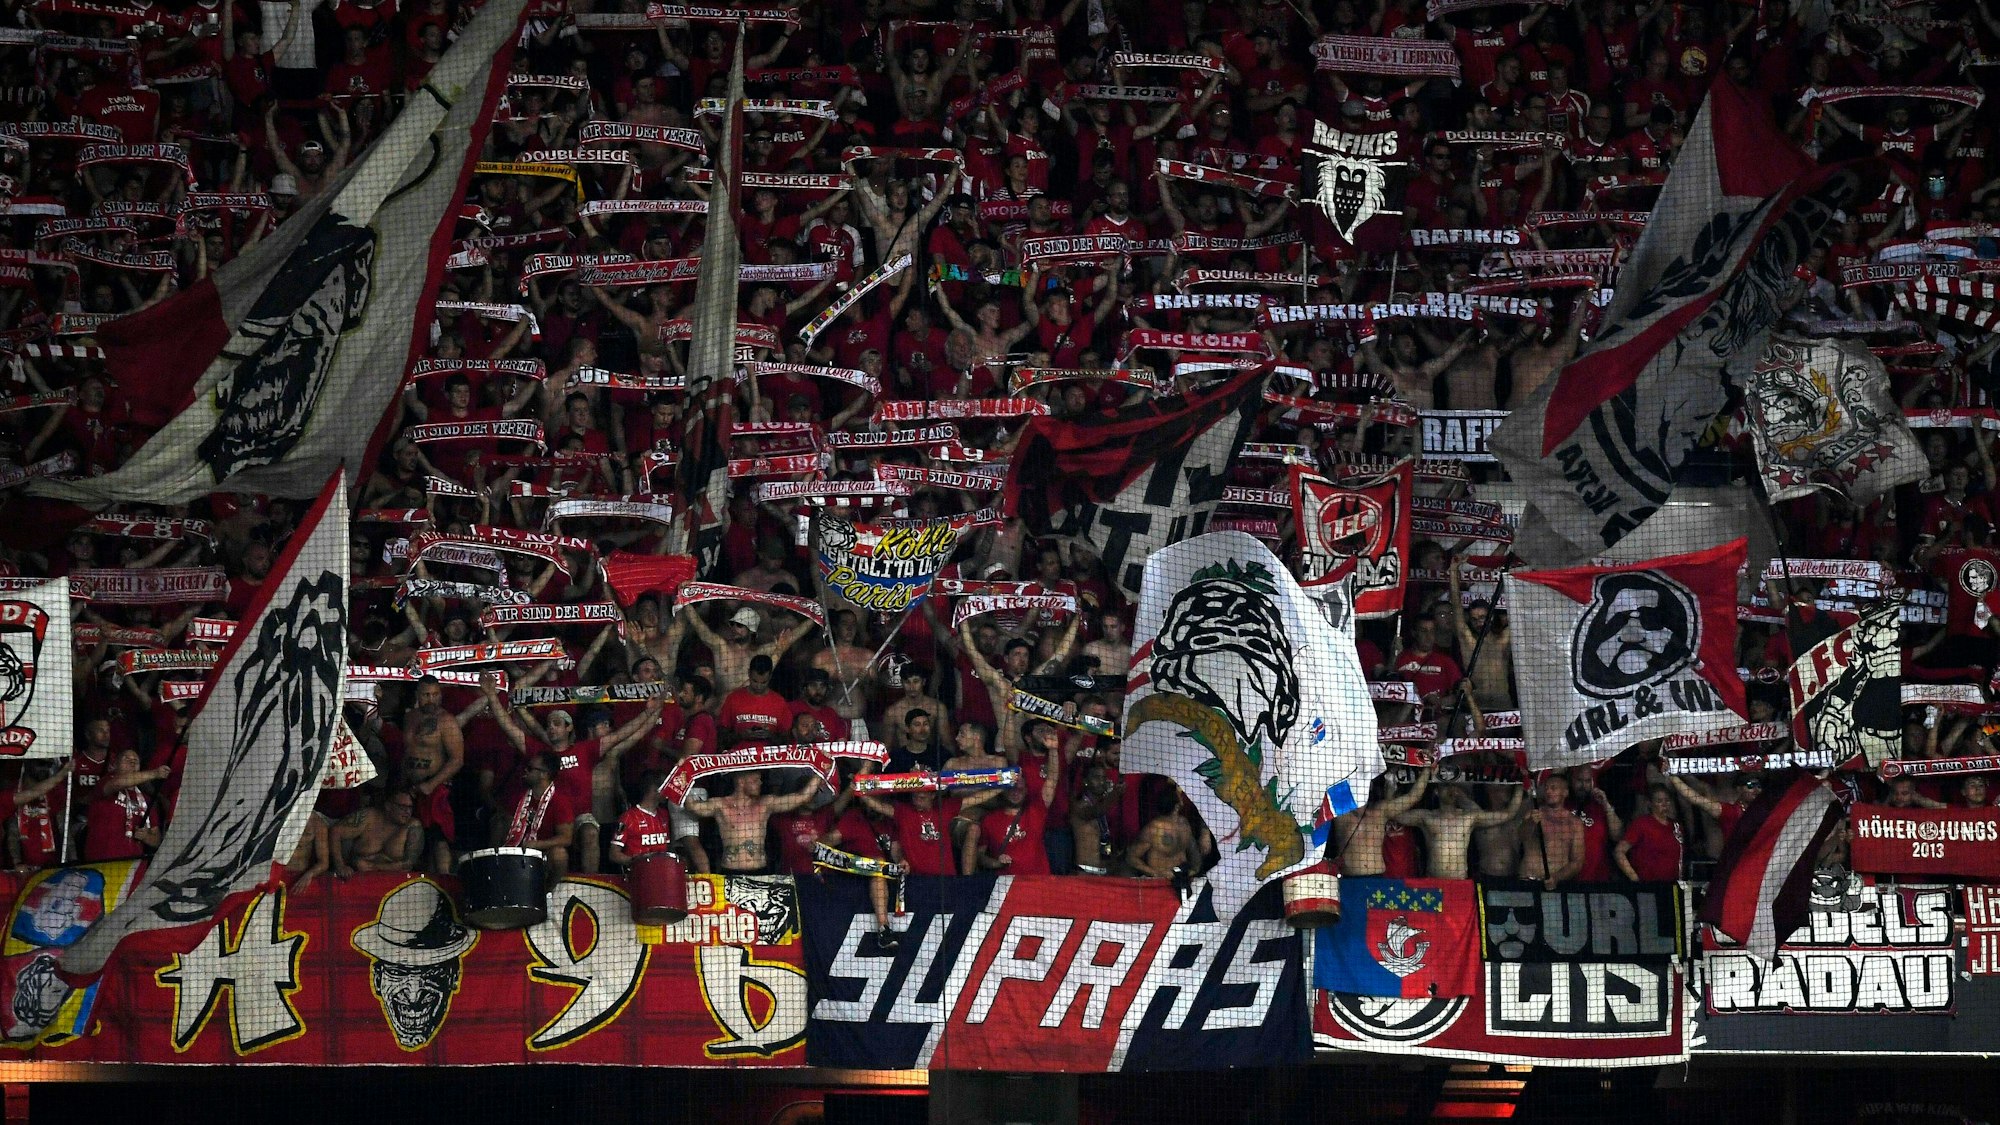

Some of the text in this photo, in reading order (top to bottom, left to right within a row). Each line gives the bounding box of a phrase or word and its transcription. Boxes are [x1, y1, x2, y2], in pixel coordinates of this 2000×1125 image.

[1332, 46, 1375, 61] VEEDEL
[1098, 87, 1118, 95] FC
[20, 122, 49, 133] SIND
[52, 122, 76, 134] DER
[582, 124, 601, 139] WIR
[604, 124, 632, 136] SIND
[635, 126, 659, 138] DER
[774, 131, 806, 142] REWE
[1312, 118, 1398, 155] RAFIKIS
[99, 144, 128, 157] SIND
[131, 144, 154, 156] DER
[1882, 141, 1914, 153] REWE
[103, 202, 131, 213] SIND
[678, 201, 707, 212] Köln
[54, 219, 82, 231] SIND
[1411, 229, 1520, 246] RAFIKIS
[1024, 238, 1093, 256] WIR SIND DER
[525, 256, 542, 274] WIR
[545, 256, 573, 268] SIND
[1843, 268, 1863, 284] WIR
[1867, 266, 1896, 280] SIND
[1898, 264, 1921, 277] DER
[1154, 293, 1262, 309] RAFIKIS
[1427, 291, 1538, 318] RAFIKIS
[1268, 304, 1366, 323] RAFIKIS
[1372, 303, 1473, 320] RAFIKIS
[1160, 333, 1183, 346] FC
[1191, 332, 1247, 348] KÖLN
[432, 359, 461, 371] SIND
[467, 359, 489, 369] DER
[492, 360, 538, 374] VEREIN
[431, 423, 537, 439] SIND DER VEREIN
[855, 431, 887, 445] SIND
[891, 430, 916, 443] DIE
[920, 424, 954, 441] FANS
[897, 468, 992, 490] WIR SIND DIE
[768, 481, 876, 497] Fussballclub Köln
[154, 523, 172, 538] 8
[873, 522, 958, 561] Kölle
[1841, 563, 1869, 577] Köln
[826, 566, 913, 611] Paris
[2, 604, 41, 629] DE
[496, 604, 580, 622] WIR SIND DER
[501, 640, 552, 656] Horde
[513, 687, 567, 704] UPRAS
[1564, 698, 1629, 750] URL
[1634, 685, 1663, 719] &
[0, 731, 31, 746] RDE
[1738, 723, 1778, 741] Köln
[690, 757, 715, 772] FÜR
[717, 753, 756, 768] IMMER
[785, 748, 818, 763] KÖLN
[1669, 749, 1834, 776] VEEDELS RADAU
[1858, 815, 1998, 842] HÖHER JUNGS
[1912, 842, 1945, 859] 2013
[812, 911, 1297, 1031] SUPRAS
[1711, 954, 1951, 1009] RADAU
